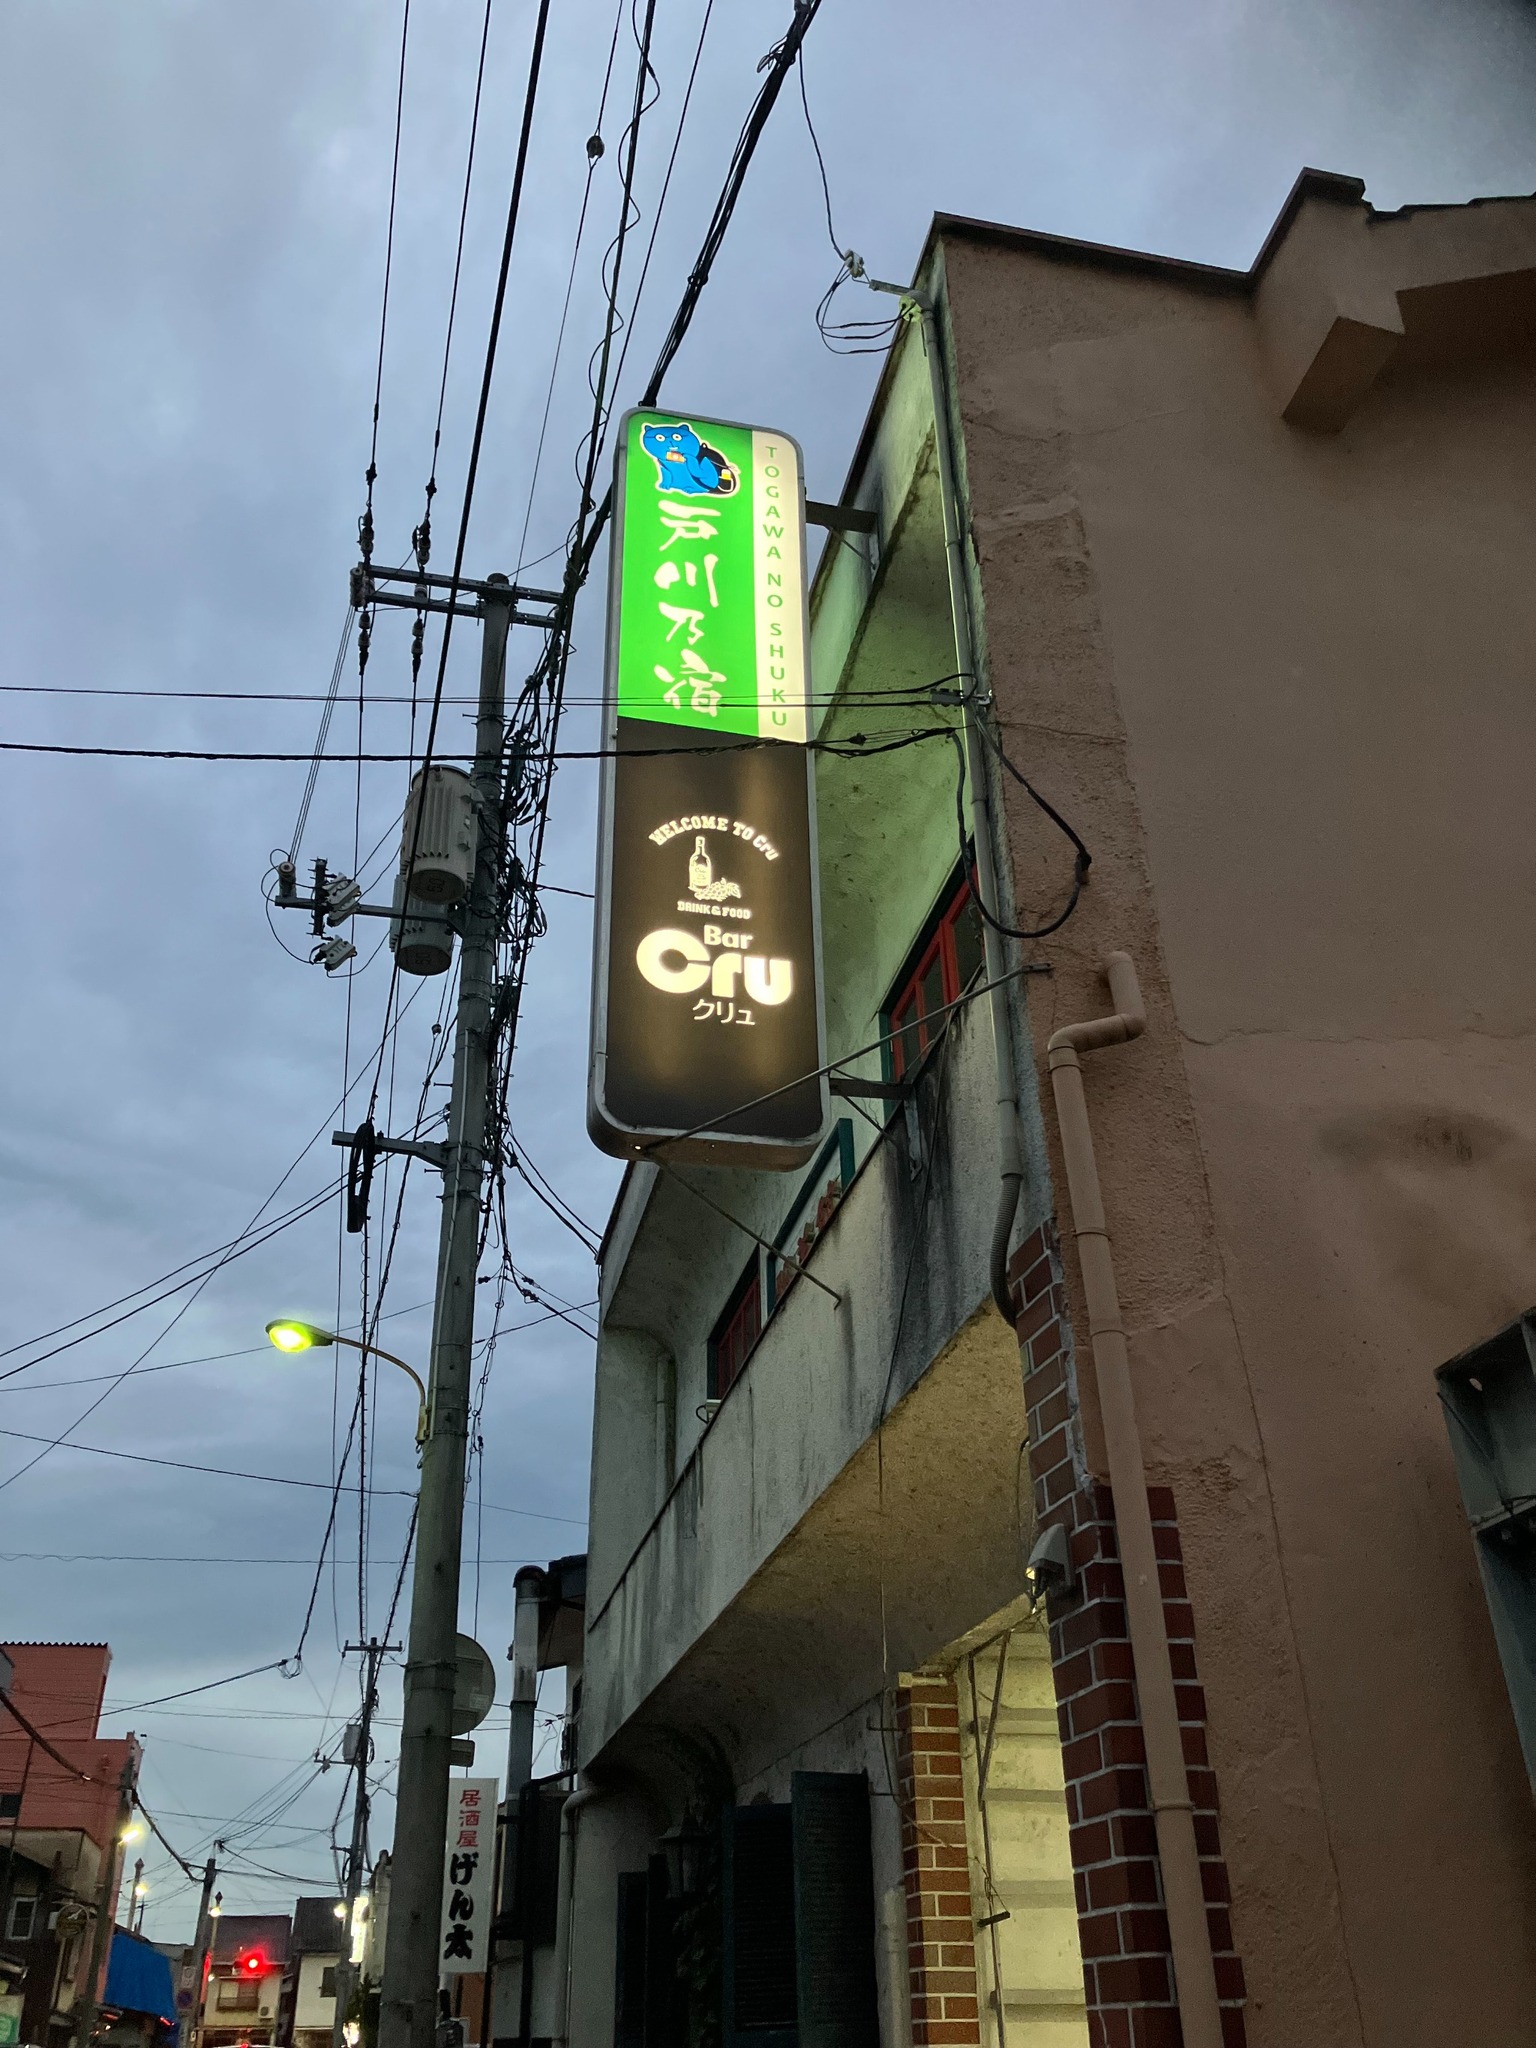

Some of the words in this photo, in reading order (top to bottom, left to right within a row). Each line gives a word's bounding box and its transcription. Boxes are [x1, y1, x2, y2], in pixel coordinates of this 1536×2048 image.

[763, 446, 784, 560] TOGAWA
[653, 499, 728, 718] 戸川乃宿
[766, 573, 784, 608] NO
[769, 622, 787, 727] SHUKU
[648, 815, 729, 847] WELCOME
[733, 821, 754, 840] TO
[635, 928, 792, 1006] Cru
[703, 924, 754, 949] Bar
[692, 998, 756, 1026] クリュ
[455, 1789, 482, 1848] 居酒屋
[443, 1851, 480, 1960] げん太
